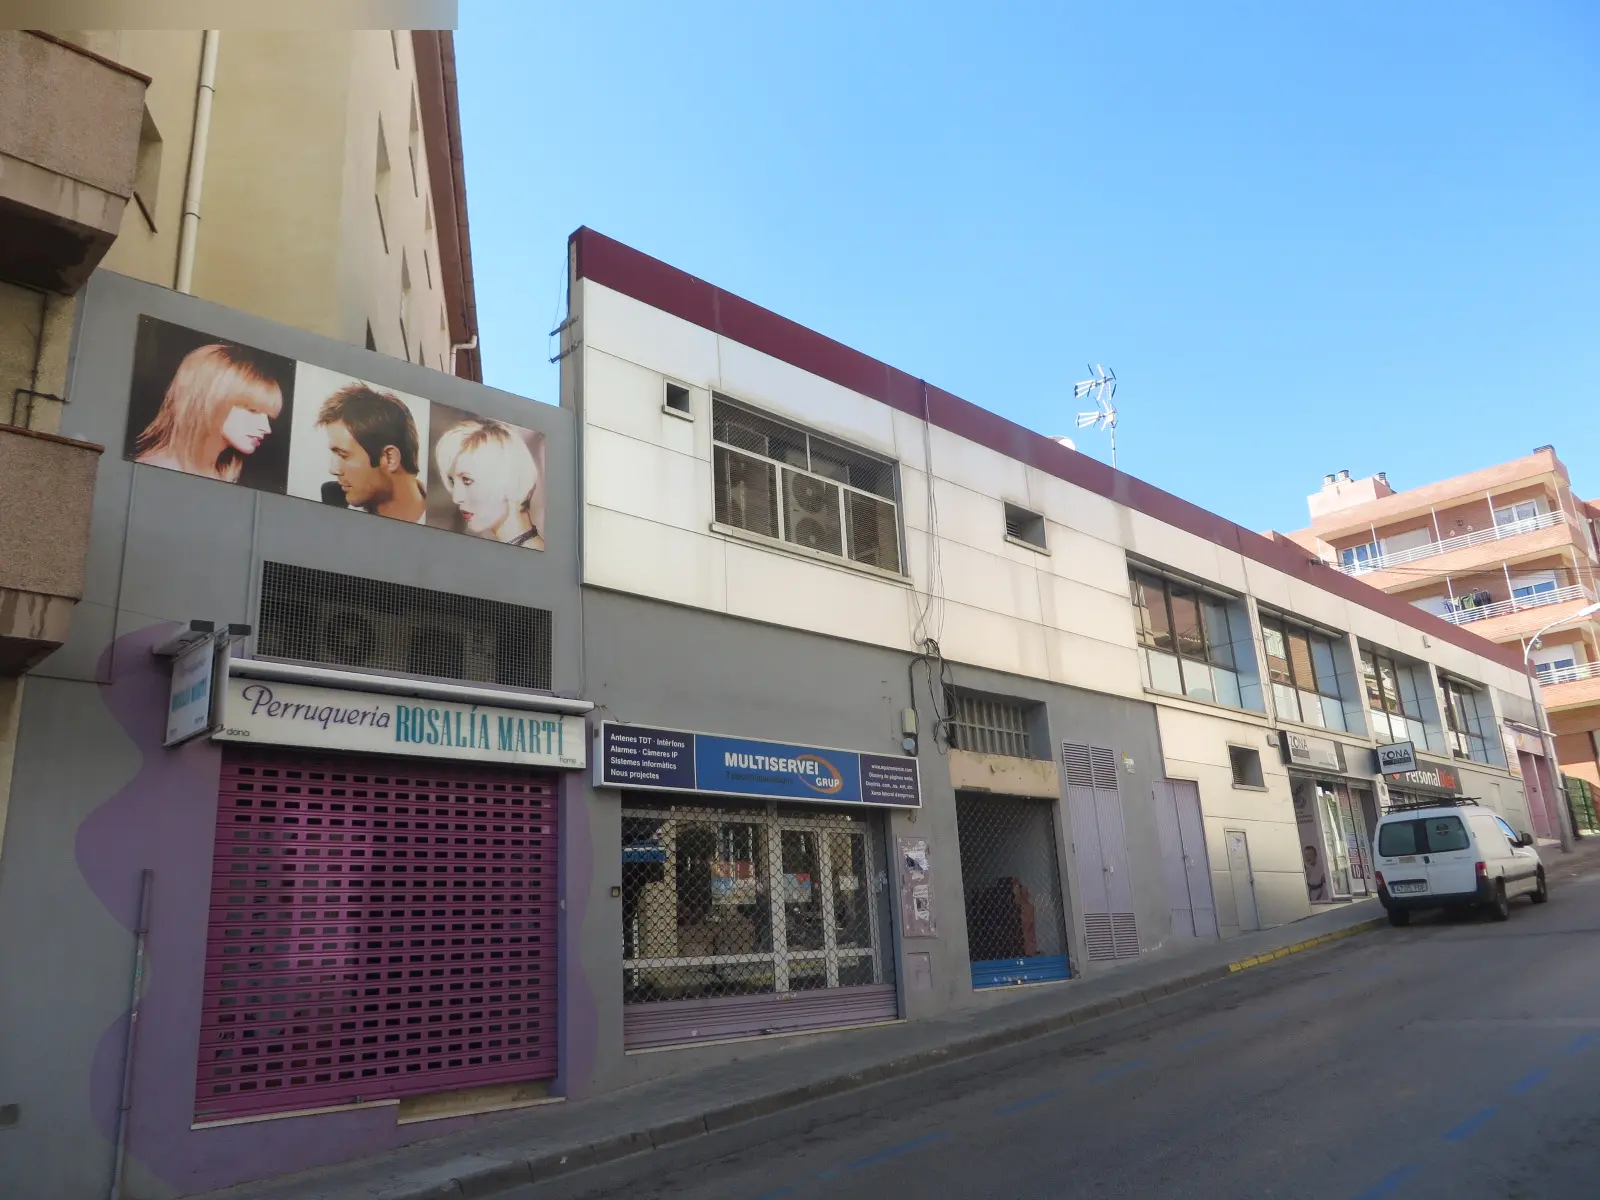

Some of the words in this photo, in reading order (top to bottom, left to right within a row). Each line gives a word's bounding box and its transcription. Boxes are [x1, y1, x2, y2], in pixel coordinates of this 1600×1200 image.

[242, 684, 391, 730] Perruqueria
[395, 704, 490, 750] ROSALÍA
[497, 715, 565, 756] MARTÍ
[226, 727, 250, 737] dona
[610, 733, 637, 743] Antenes
[638, 736, 652, 744] TDT
[656, 738, 685, 748] Intèrfons
[610, 745, 637, 755] Alarmes
[642, 748, 670, 758] Càmeres
[1380, 748, 1411, 761] ZONA
[610, 757, 640, 766] Sistemes
[641, 760, 677, 770] informàtics
[724, 751, 819, 776] MULTISERVEI
[610, 768, 628, 777] Nous
[629, 771, 659, 779] projectes
[815, 777, 841, 788] GRUP
